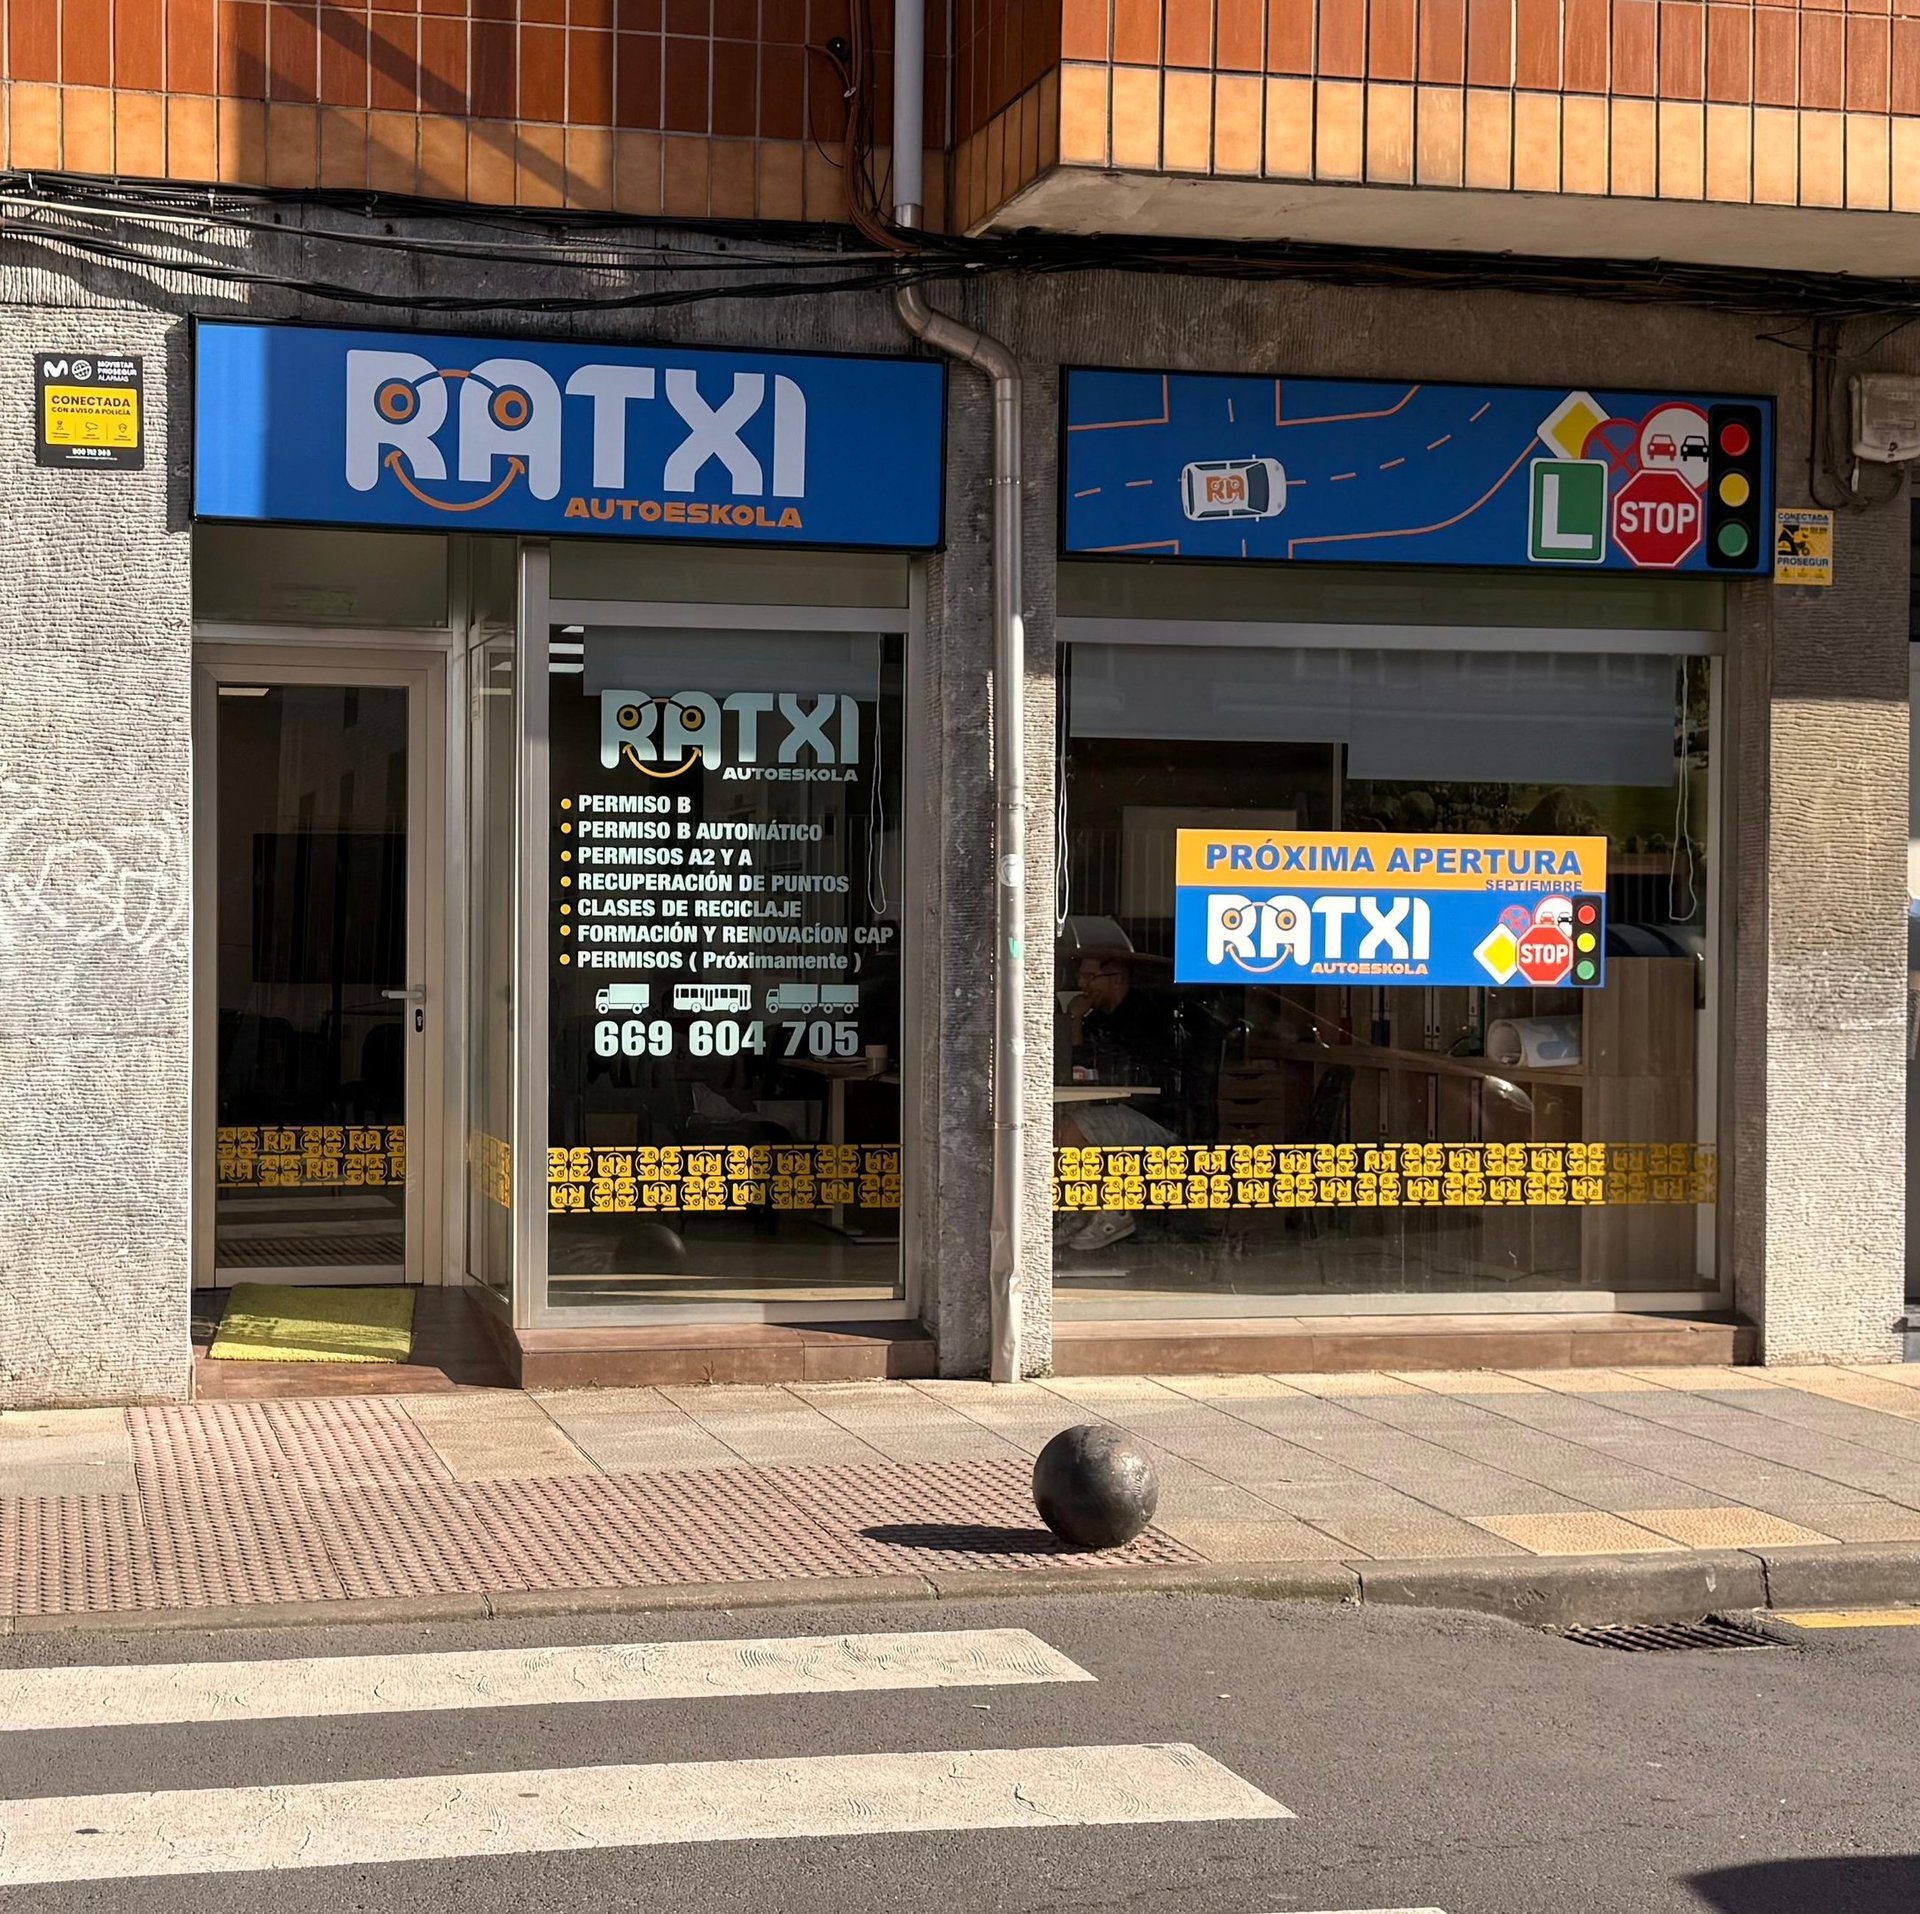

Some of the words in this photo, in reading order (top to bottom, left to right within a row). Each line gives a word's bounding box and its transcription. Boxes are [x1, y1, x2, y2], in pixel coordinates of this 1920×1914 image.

[51, 395, 131, 407] CONECTADA
[346, 349, 807, 500] RATXI
[564, 497, 803, 528] AUTOESKOLA
[1541, 474, 1593, 549] L
[1620, 502, 1695, 534] STOP
[1778, 513, 1828, 521] CONECTADA
[1777, 557, 1828, 566] PROSEGUR
[600, 690, 859, 770] RATXI
[722, 767, 858, 781] AUTOESKOLA
[579, 795, 670, 813] PERMISO
[678, 797, 691, 813] B
[579, 822, 670, 839] PERMISO
[677, 823, 690, 839] B
[696, 820, 821, 840] AUTOMÁTICO
[579, 848, 683, 865] PERMISOS
[688, 849, 715, 865] A2
[720, 849, 734, 865] Y
[738, 849, 752, 866] A
[1206, 839, 1375, 872] PRÓXIMA
[1386, 847, 1582, 875] APERTURA
[579, 871, 732, 891] RECUPERACIÓN
[739, 875, 764, 891] DE
[772, 876, 849, 892] PUNTOS
[1485, 879, 1583, 892] SEPTIEMBRE
[578, 900, 655, 917] CLASES
[662, 900, 687, 917] DE
[695, 901, 801, 918] RECICLAJE
[578, 922, 697, 942] FORMACIÓN
[703, 926, 716, 942] Y
[854, 927, 893, 944] CAP
[1207, 894, 1430, 965] RATXI
[578, 951, 683, 968] PERMISOS
[1520, 943, 1568, 964] STOP
[1311, 961, 1428, 976] AUTOESKOLA
[594, 1020, 672, 1056] 669
[689, 1020, 765, 1056] 604
[782, 1020, 858, 1056] 705
